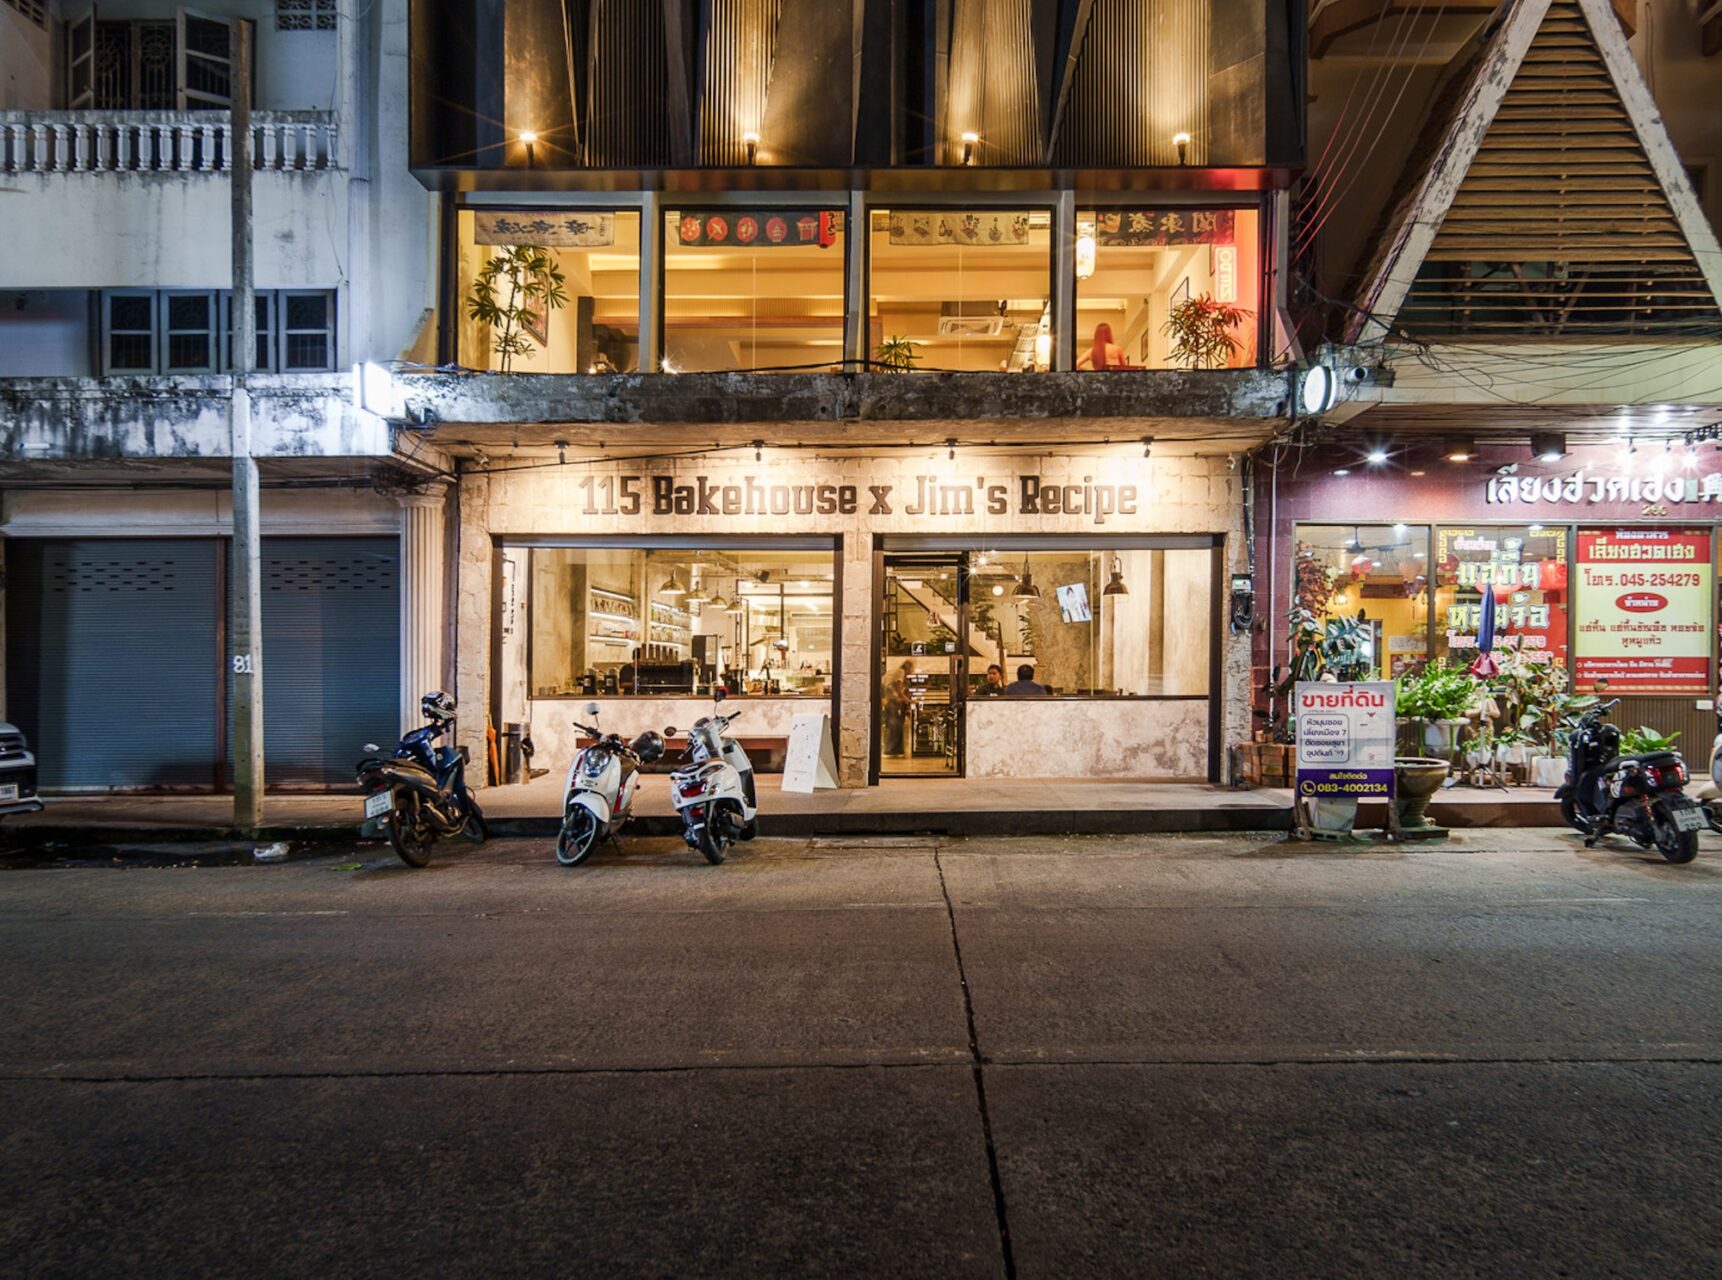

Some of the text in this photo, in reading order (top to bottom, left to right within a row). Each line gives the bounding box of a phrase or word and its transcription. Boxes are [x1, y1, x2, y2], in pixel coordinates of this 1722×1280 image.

[578, 475, 1137, 524] 115 Bakehouse x Jim's Recipe
[233, 654, 253, 673] 81
[1302, 684, 1385, 708] ขายที่ดิน
[1317, 782, 1388, 793] 083-4002134
